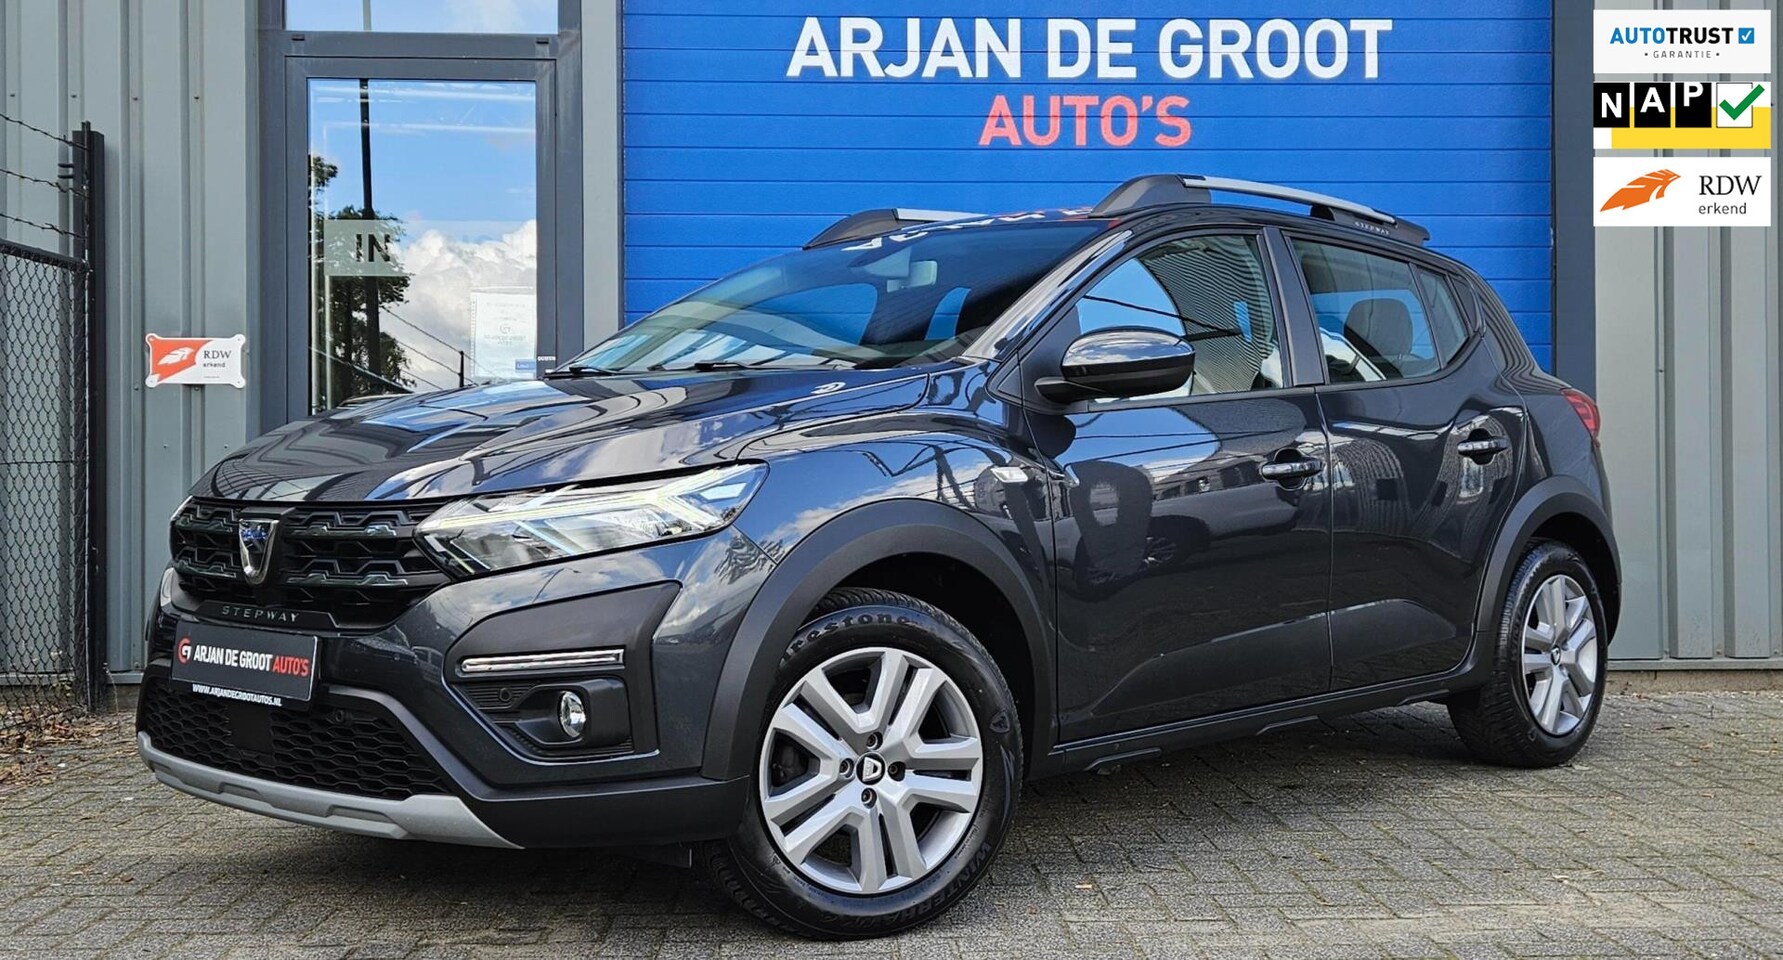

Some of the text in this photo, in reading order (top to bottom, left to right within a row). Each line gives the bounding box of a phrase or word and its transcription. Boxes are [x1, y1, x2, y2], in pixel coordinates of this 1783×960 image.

[786, 16, 1393, 79] ARJAN DE GROOT
[979, 95, 1192, 146] AUTO'S
[355, 233, 391, 263] IN
[203, 350, 232, 360] RDW
[222, 605, 300, 623] STEPWAY
[779, 612, 913, 667] irestone
[193, 644, 310, 677] ARJAN DE GROOT AUTO'S
